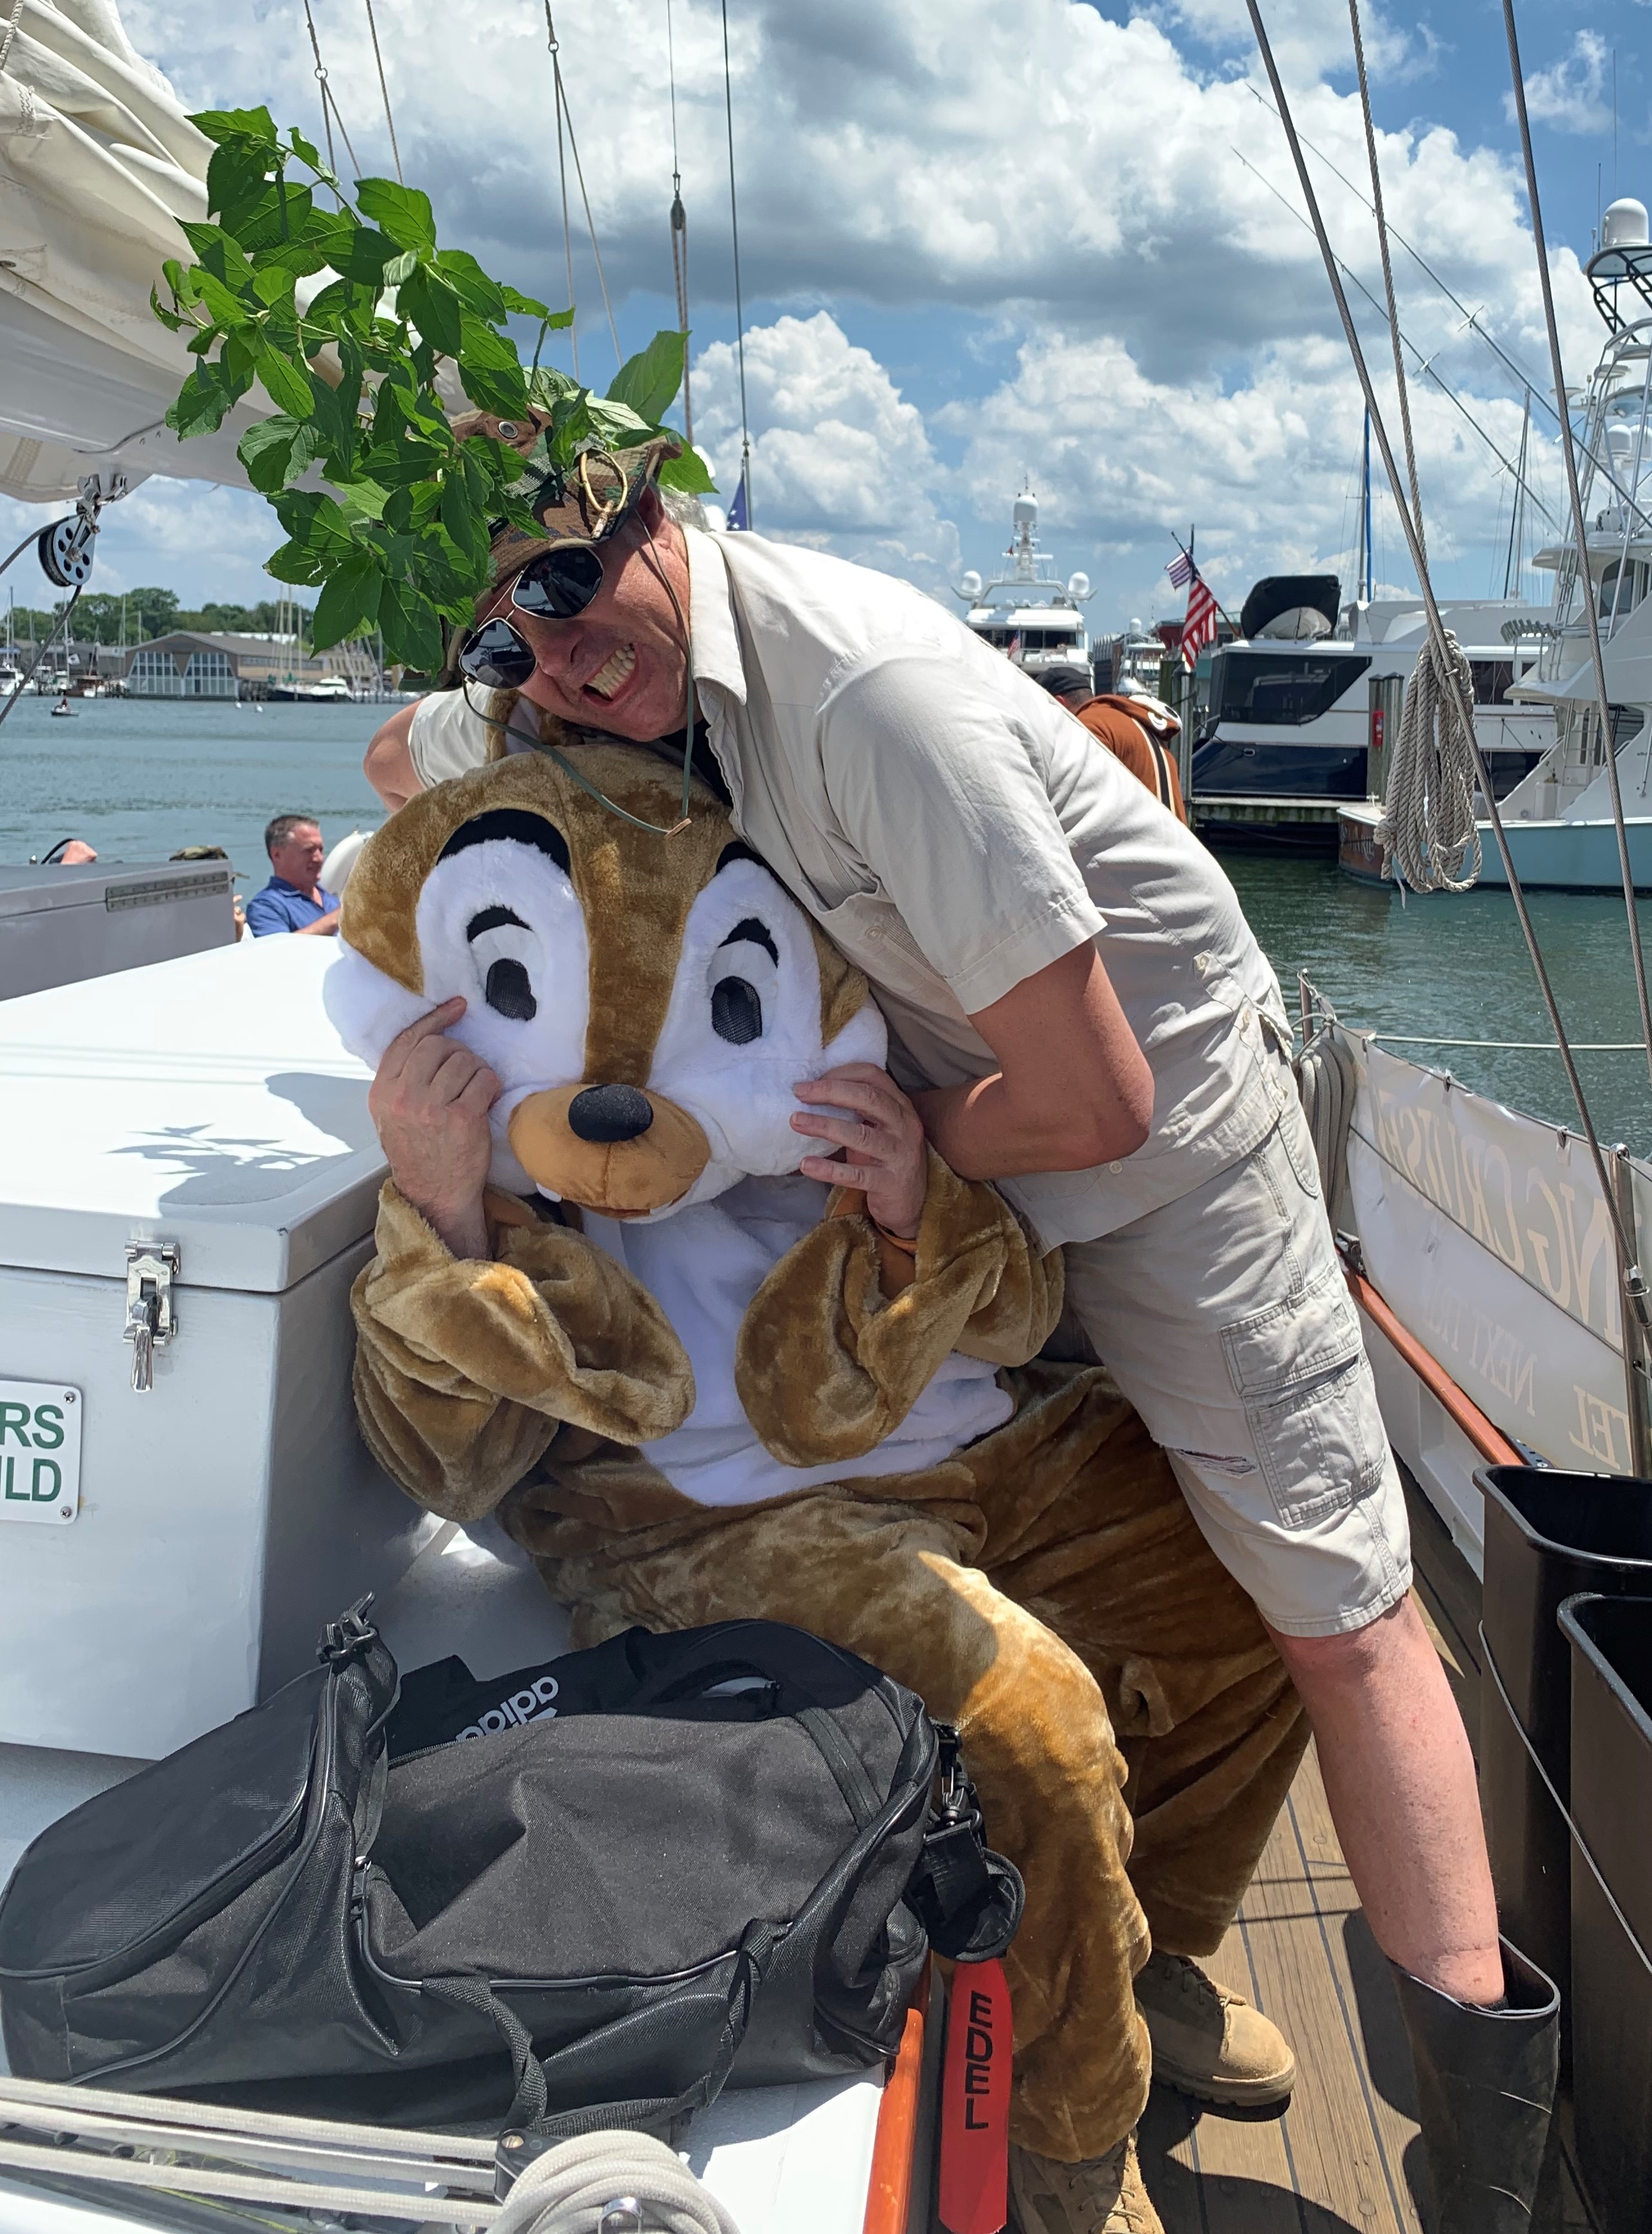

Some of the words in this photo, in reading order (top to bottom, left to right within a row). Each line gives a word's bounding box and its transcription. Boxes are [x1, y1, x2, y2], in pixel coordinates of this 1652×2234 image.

[0, 1455, 62, 1502] LD
[455, 1676, 559, 1742] adida
[965, 1989, 993, 2130] EDEL
